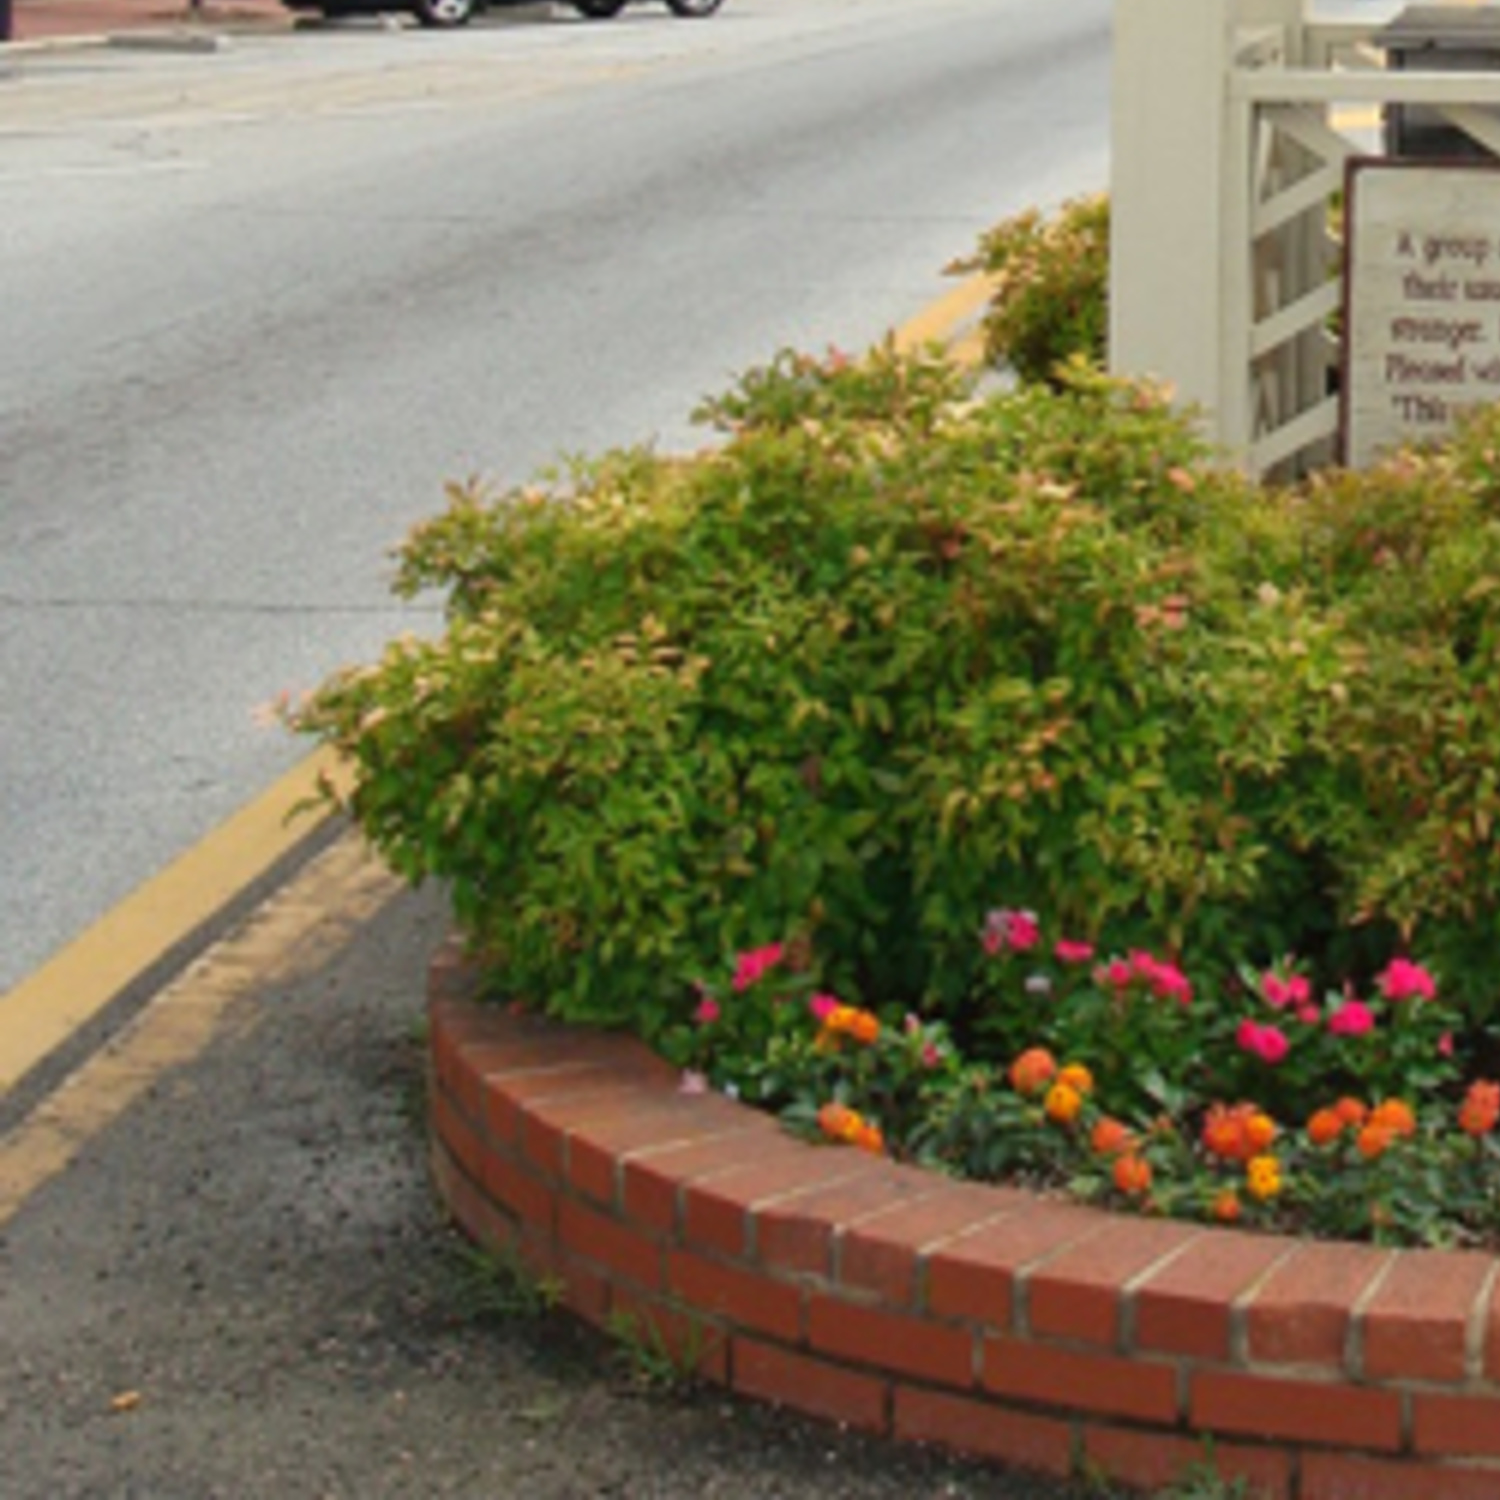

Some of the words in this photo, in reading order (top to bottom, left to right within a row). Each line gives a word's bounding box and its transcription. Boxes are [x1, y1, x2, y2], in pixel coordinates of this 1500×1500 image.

[1396, 231, 1416, 257] A
[1423, 238, 1488, 267] group
[1403, 270, 1458, 300] their
